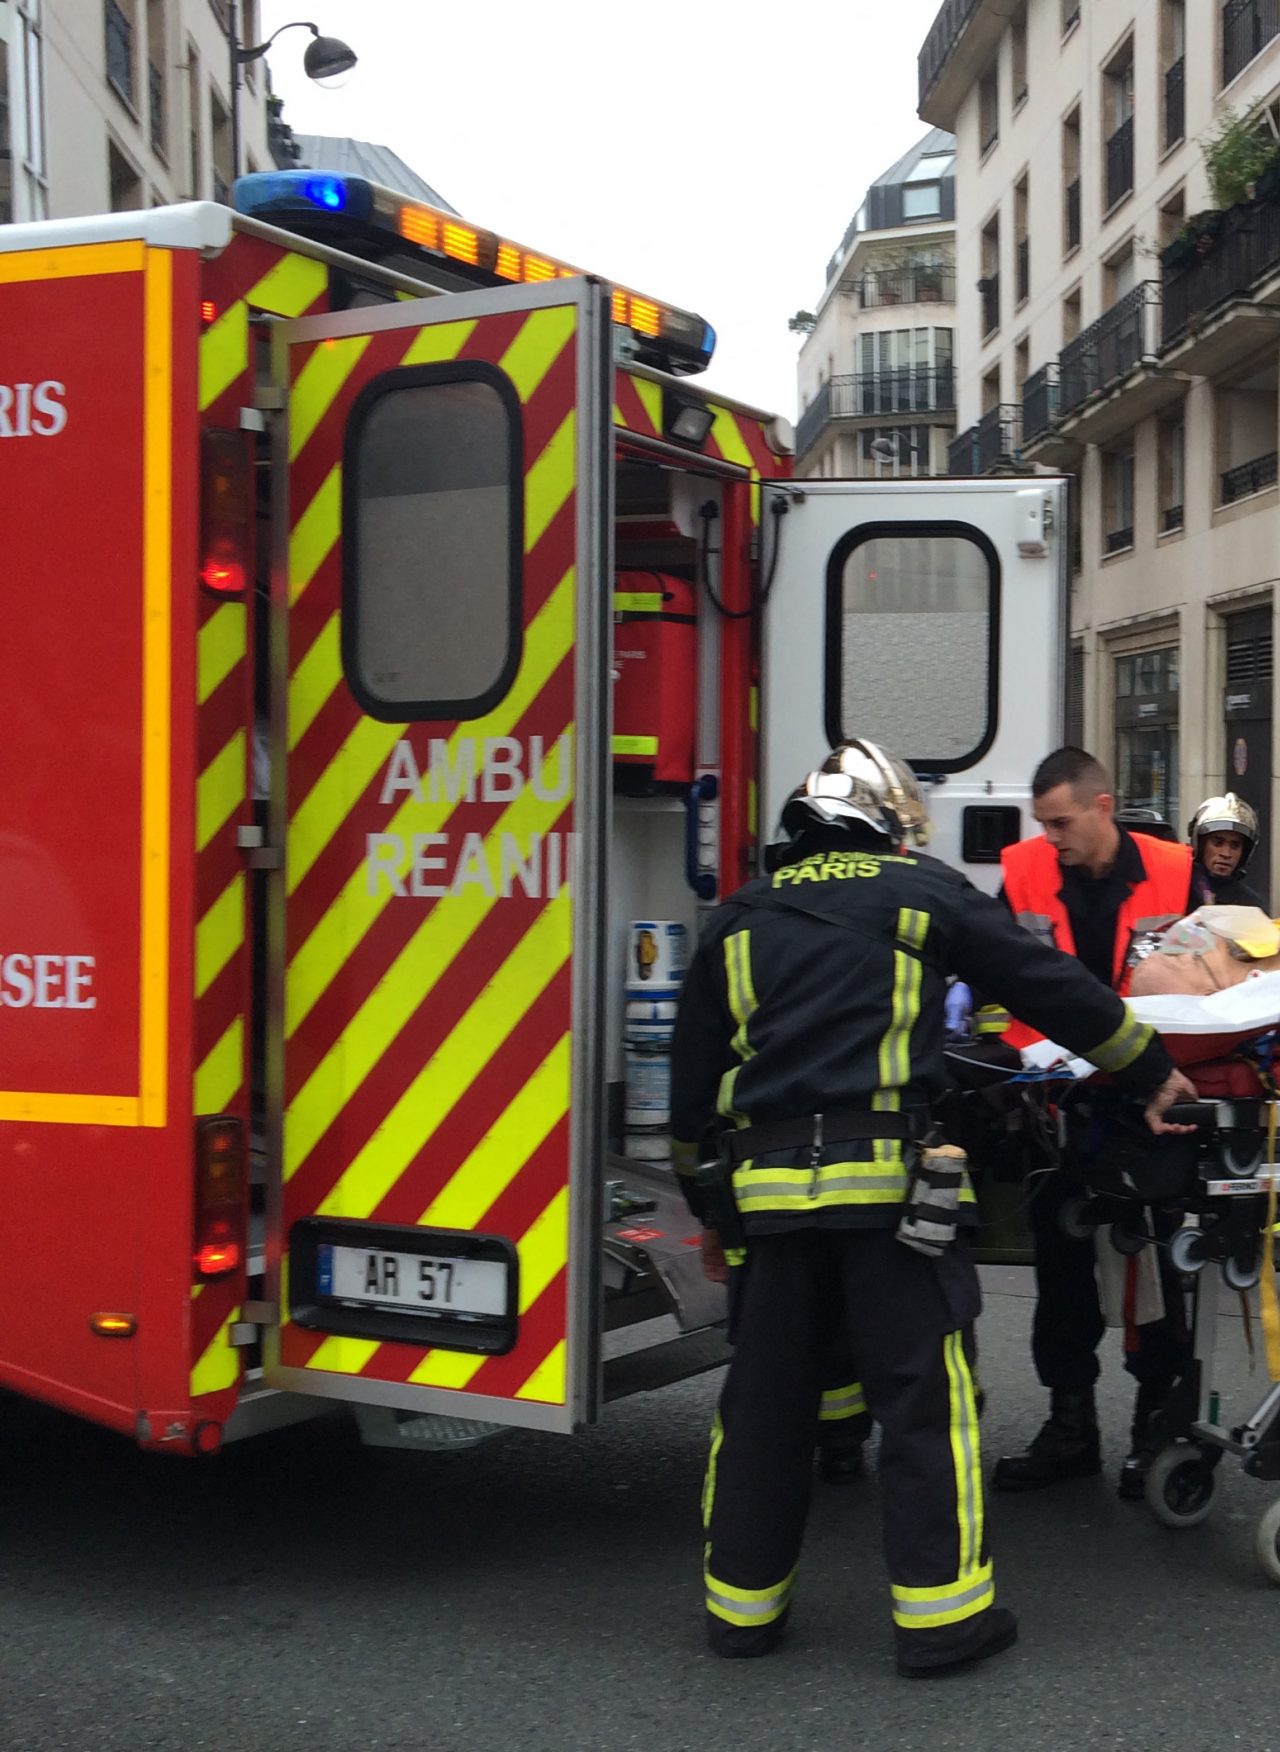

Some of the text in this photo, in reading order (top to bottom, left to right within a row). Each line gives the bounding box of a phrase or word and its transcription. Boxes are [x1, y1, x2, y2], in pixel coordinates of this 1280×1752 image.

[378, 734, 572, 804] AMBU
[771, 860, 882, 889] PARIS
[0, 953, 97, 1009] SEE
[365, 1254, 399, 1297] AR
[418, 1259, 453, 1303] 57
